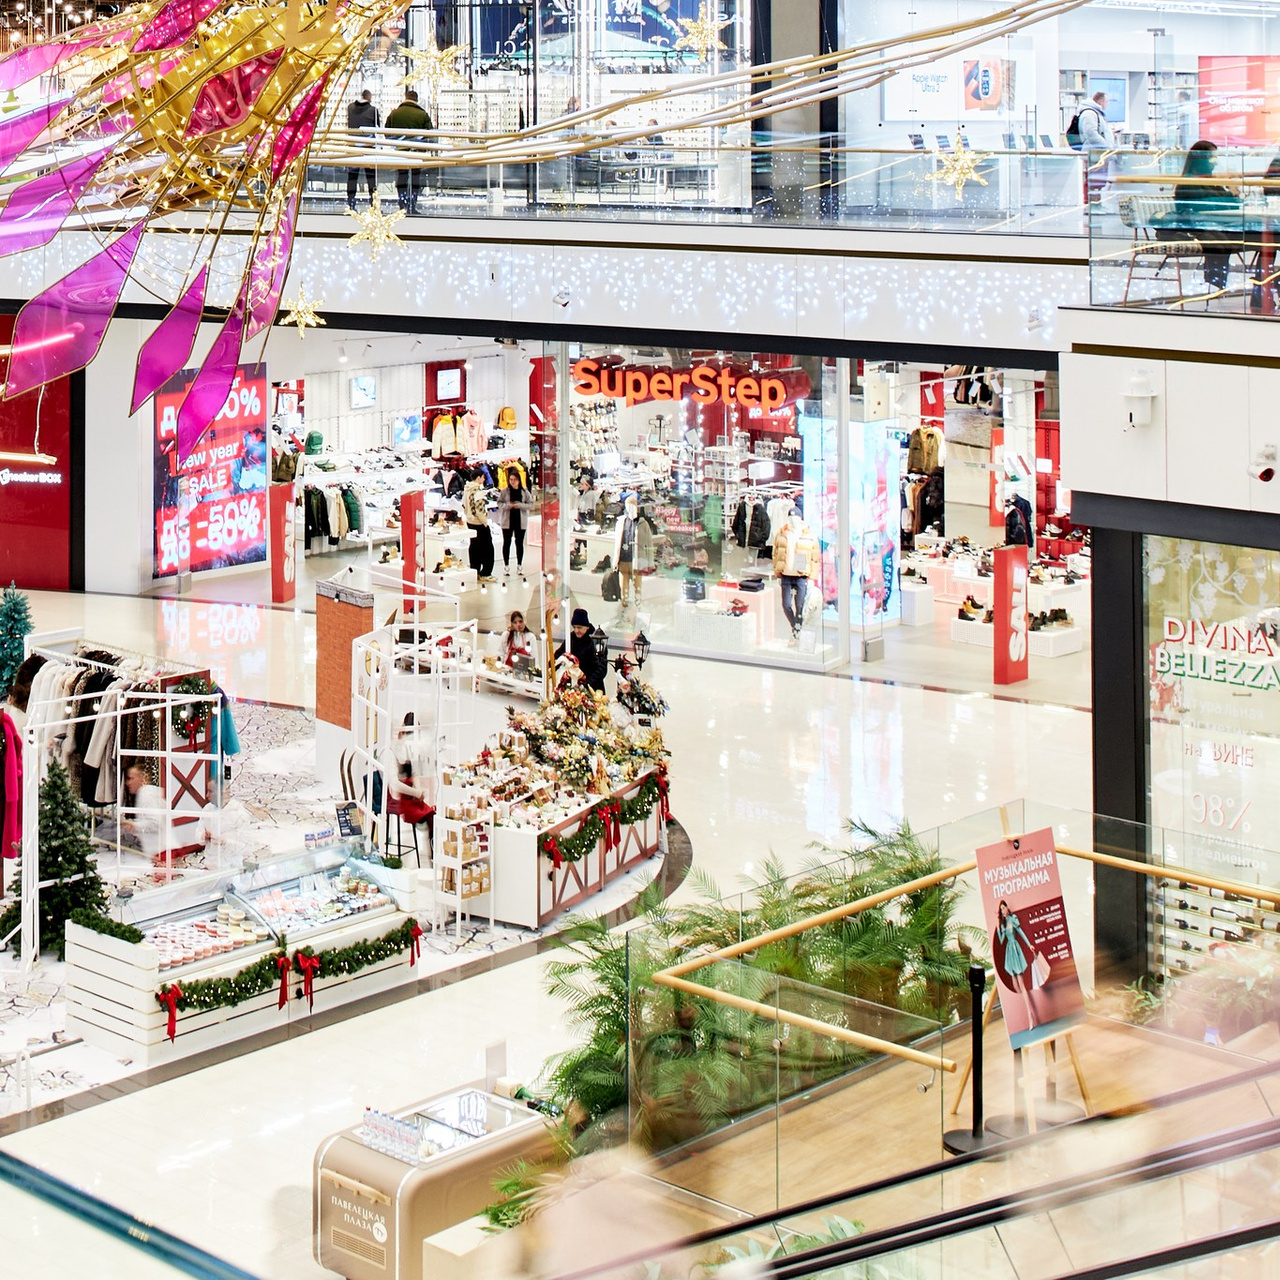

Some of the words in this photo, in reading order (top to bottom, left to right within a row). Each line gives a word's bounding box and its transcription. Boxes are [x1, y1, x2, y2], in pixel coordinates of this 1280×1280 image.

[573, 359, 787, 413] SuperStep
[209, 442, 240, 467] year
[189, 468, 228, 495] SALE
[1162, 616, 1274, 658] DIVINA
[1154, 646, 1280, 692] BELLEZZA
[1190, 791, 1253, 834] 98%
[984, 851, 1054, 885] МУЗЫКАЛЬНАЯ
[992, 870, 1051, 899] ПРОГРАММА
[331, 1195, 386, 1225] ПАВЕЛЕЦКАЯ
[344, 1213, 372, 1233] ПЛАЗА
